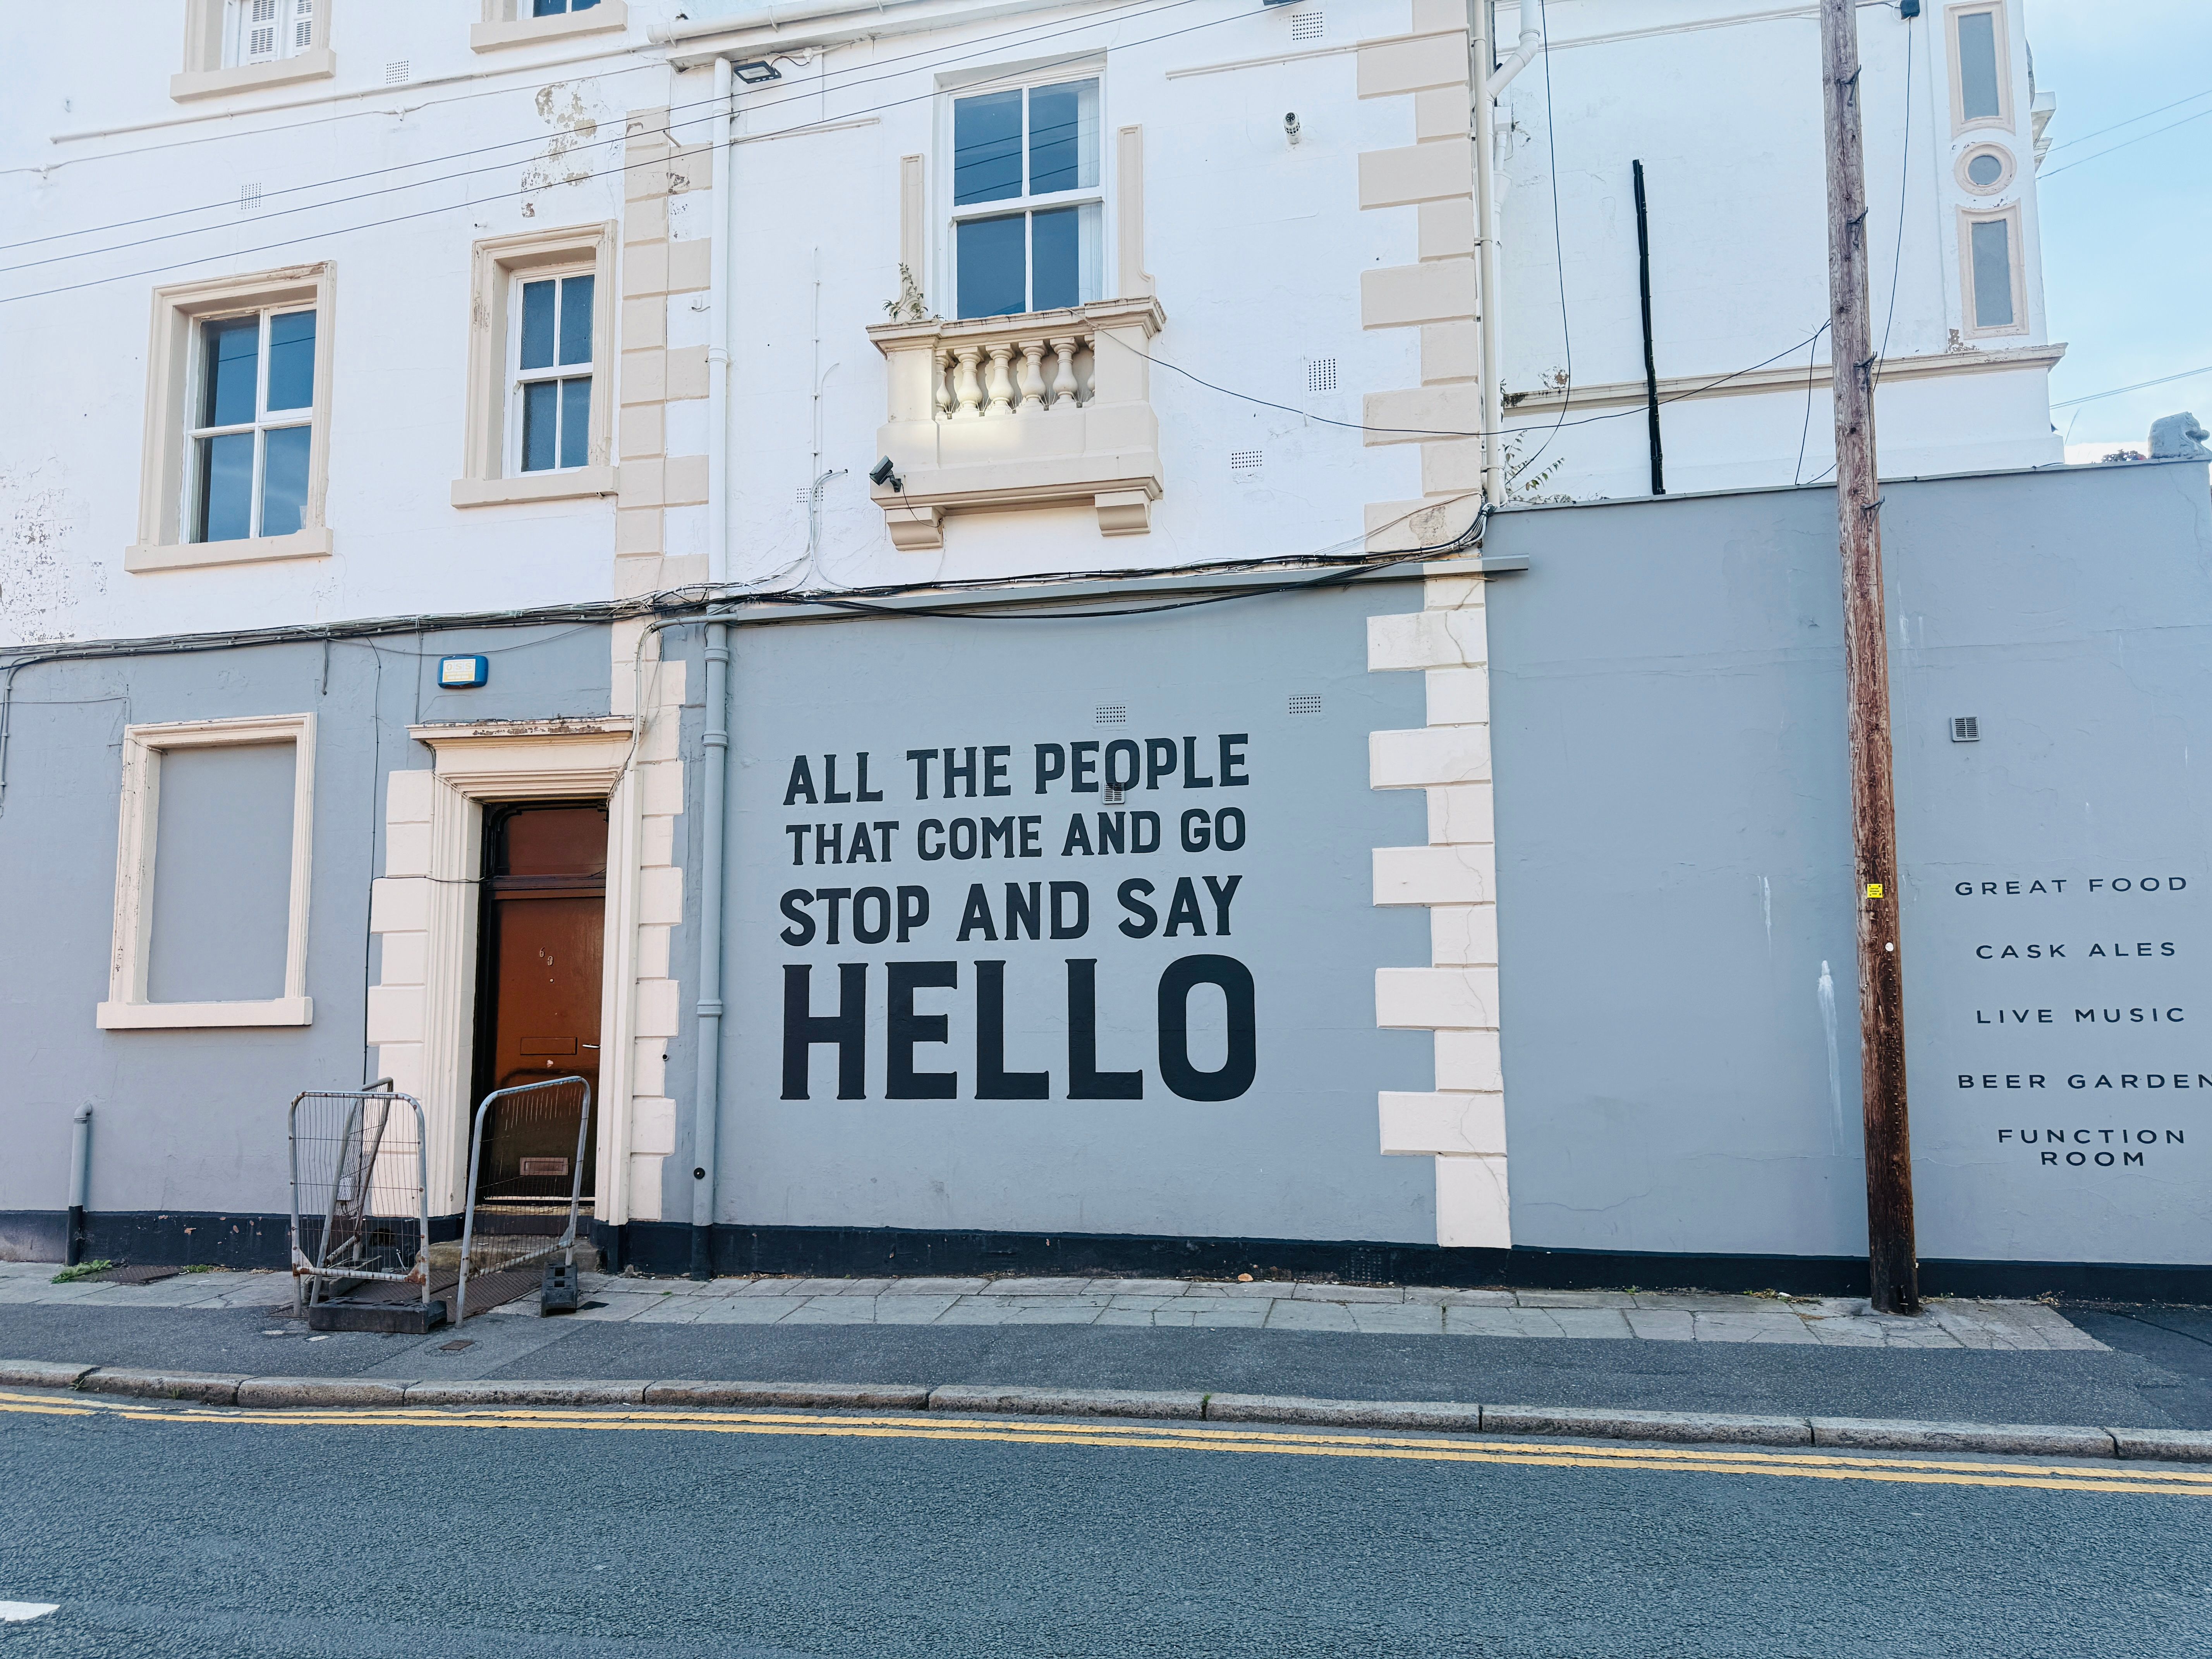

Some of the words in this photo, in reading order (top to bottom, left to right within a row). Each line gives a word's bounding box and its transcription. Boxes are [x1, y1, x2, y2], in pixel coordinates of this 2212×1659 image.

[783, 752, 883, 805] ALL
[907, 745, 1011, 800] THE
[1034, 733, 1249, 794] PEOPLE
[786, 821, 899, 865] THAT
[918, 815, 1042, 860] COME
[1061, 811, 1160, 856] AND
[1181, 807, 1245, 852] GO
[1956, 880, 2066, 895] GREAT
[2089, 878, 2186, 891] FOOD
[780, 886, 929, 946] STOP
[956, 881, 1089, 941] AND
[1118, 875, 1242, 938] SAY
[539, 946, 553, 966] 60
[1977, 945, 2065, 959] CASK
[2089, 943, 2174, 957] ALES
[1977, 1010, 2052, 1023] LIVE
[2075, 1008, 2184, 1022] MUSIC
[780, 954, 1256, 1102] HELLO
[1958, 1075, 2045, 1088] BEER
[2068, 1075, 2212, 1089] GARDEN
[1999, 1130, 2184, 1144] FUNCTION
[2041, 1152, 2143, 1166] ROOM
